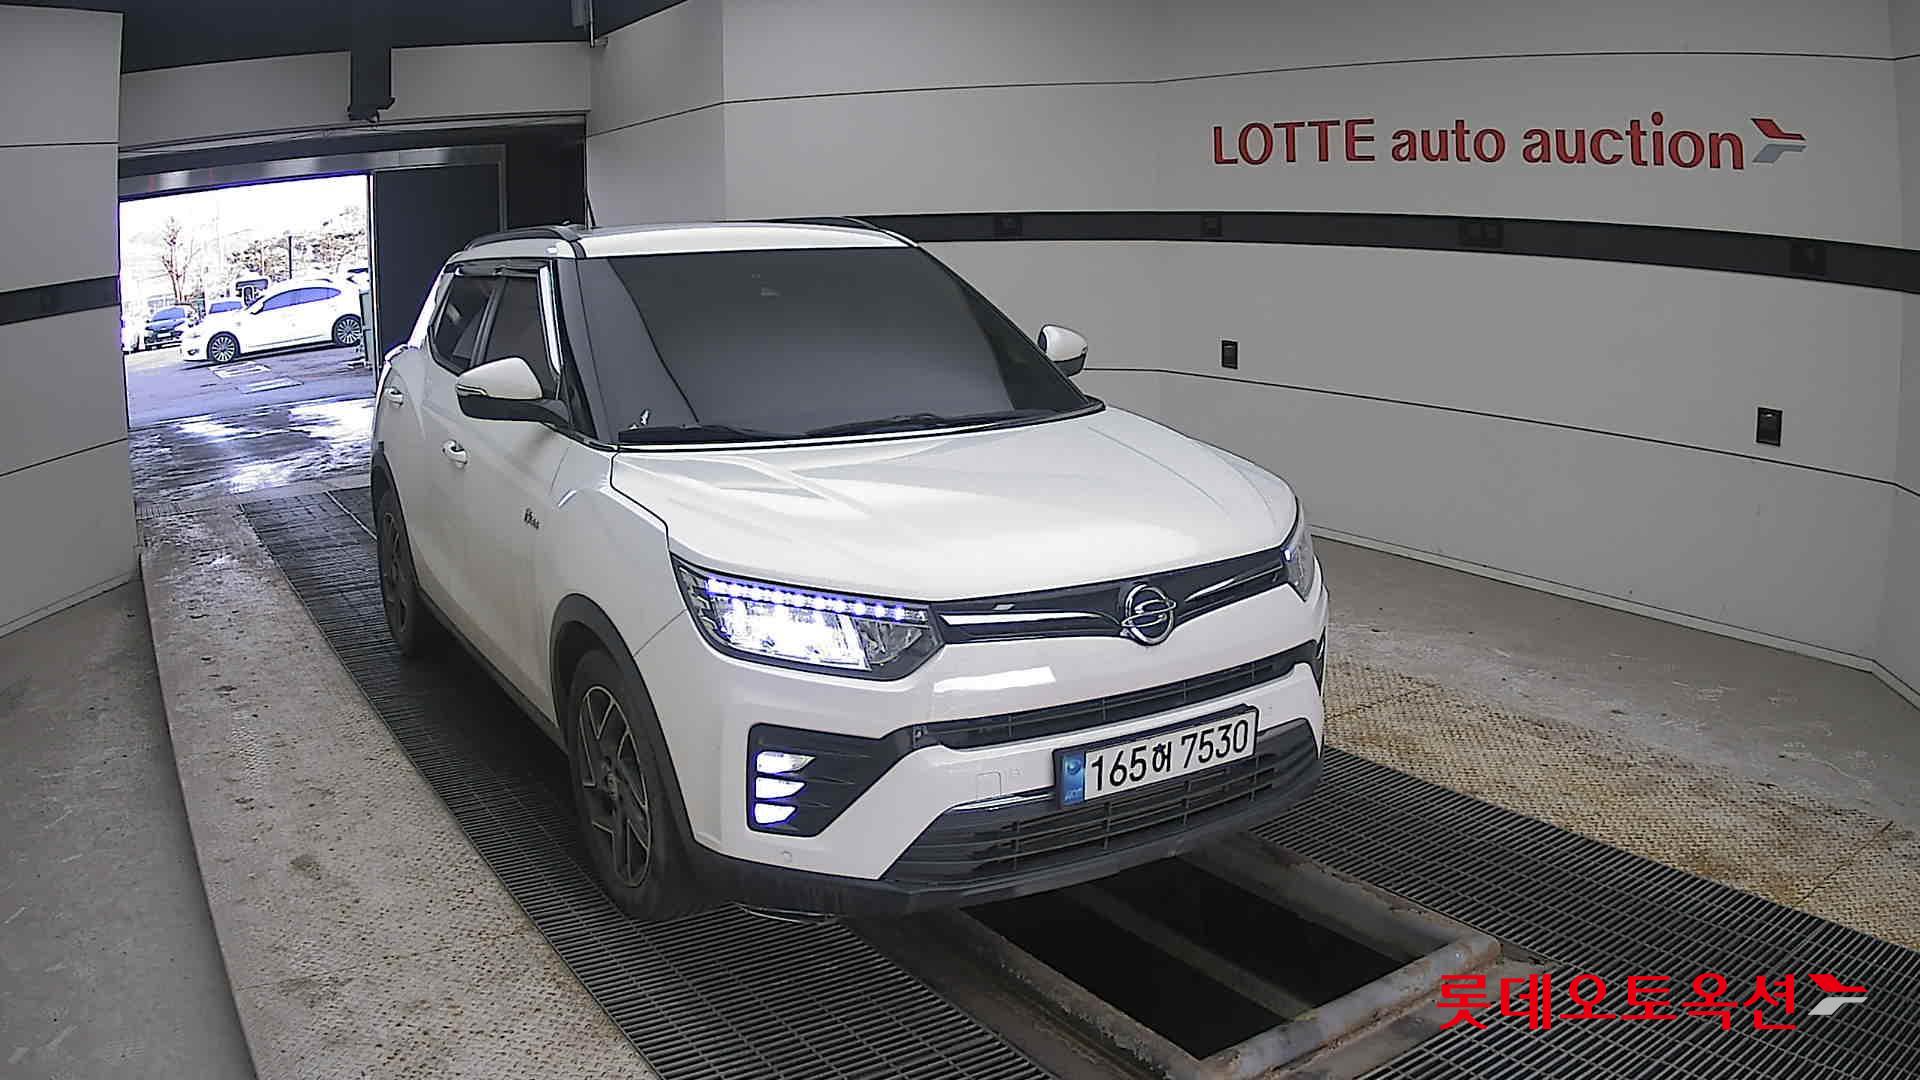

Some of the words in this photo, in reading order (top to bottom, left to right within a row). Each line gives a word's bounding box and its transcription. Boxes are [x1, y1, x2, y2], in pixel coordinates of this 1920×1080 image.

[1212, 118, 1376, 166] LOTTE
[1391, 119, 1506, 164] auto
[1521, 111, 1745, 171] auction
[1180, 719, 1249, 769] 7530
